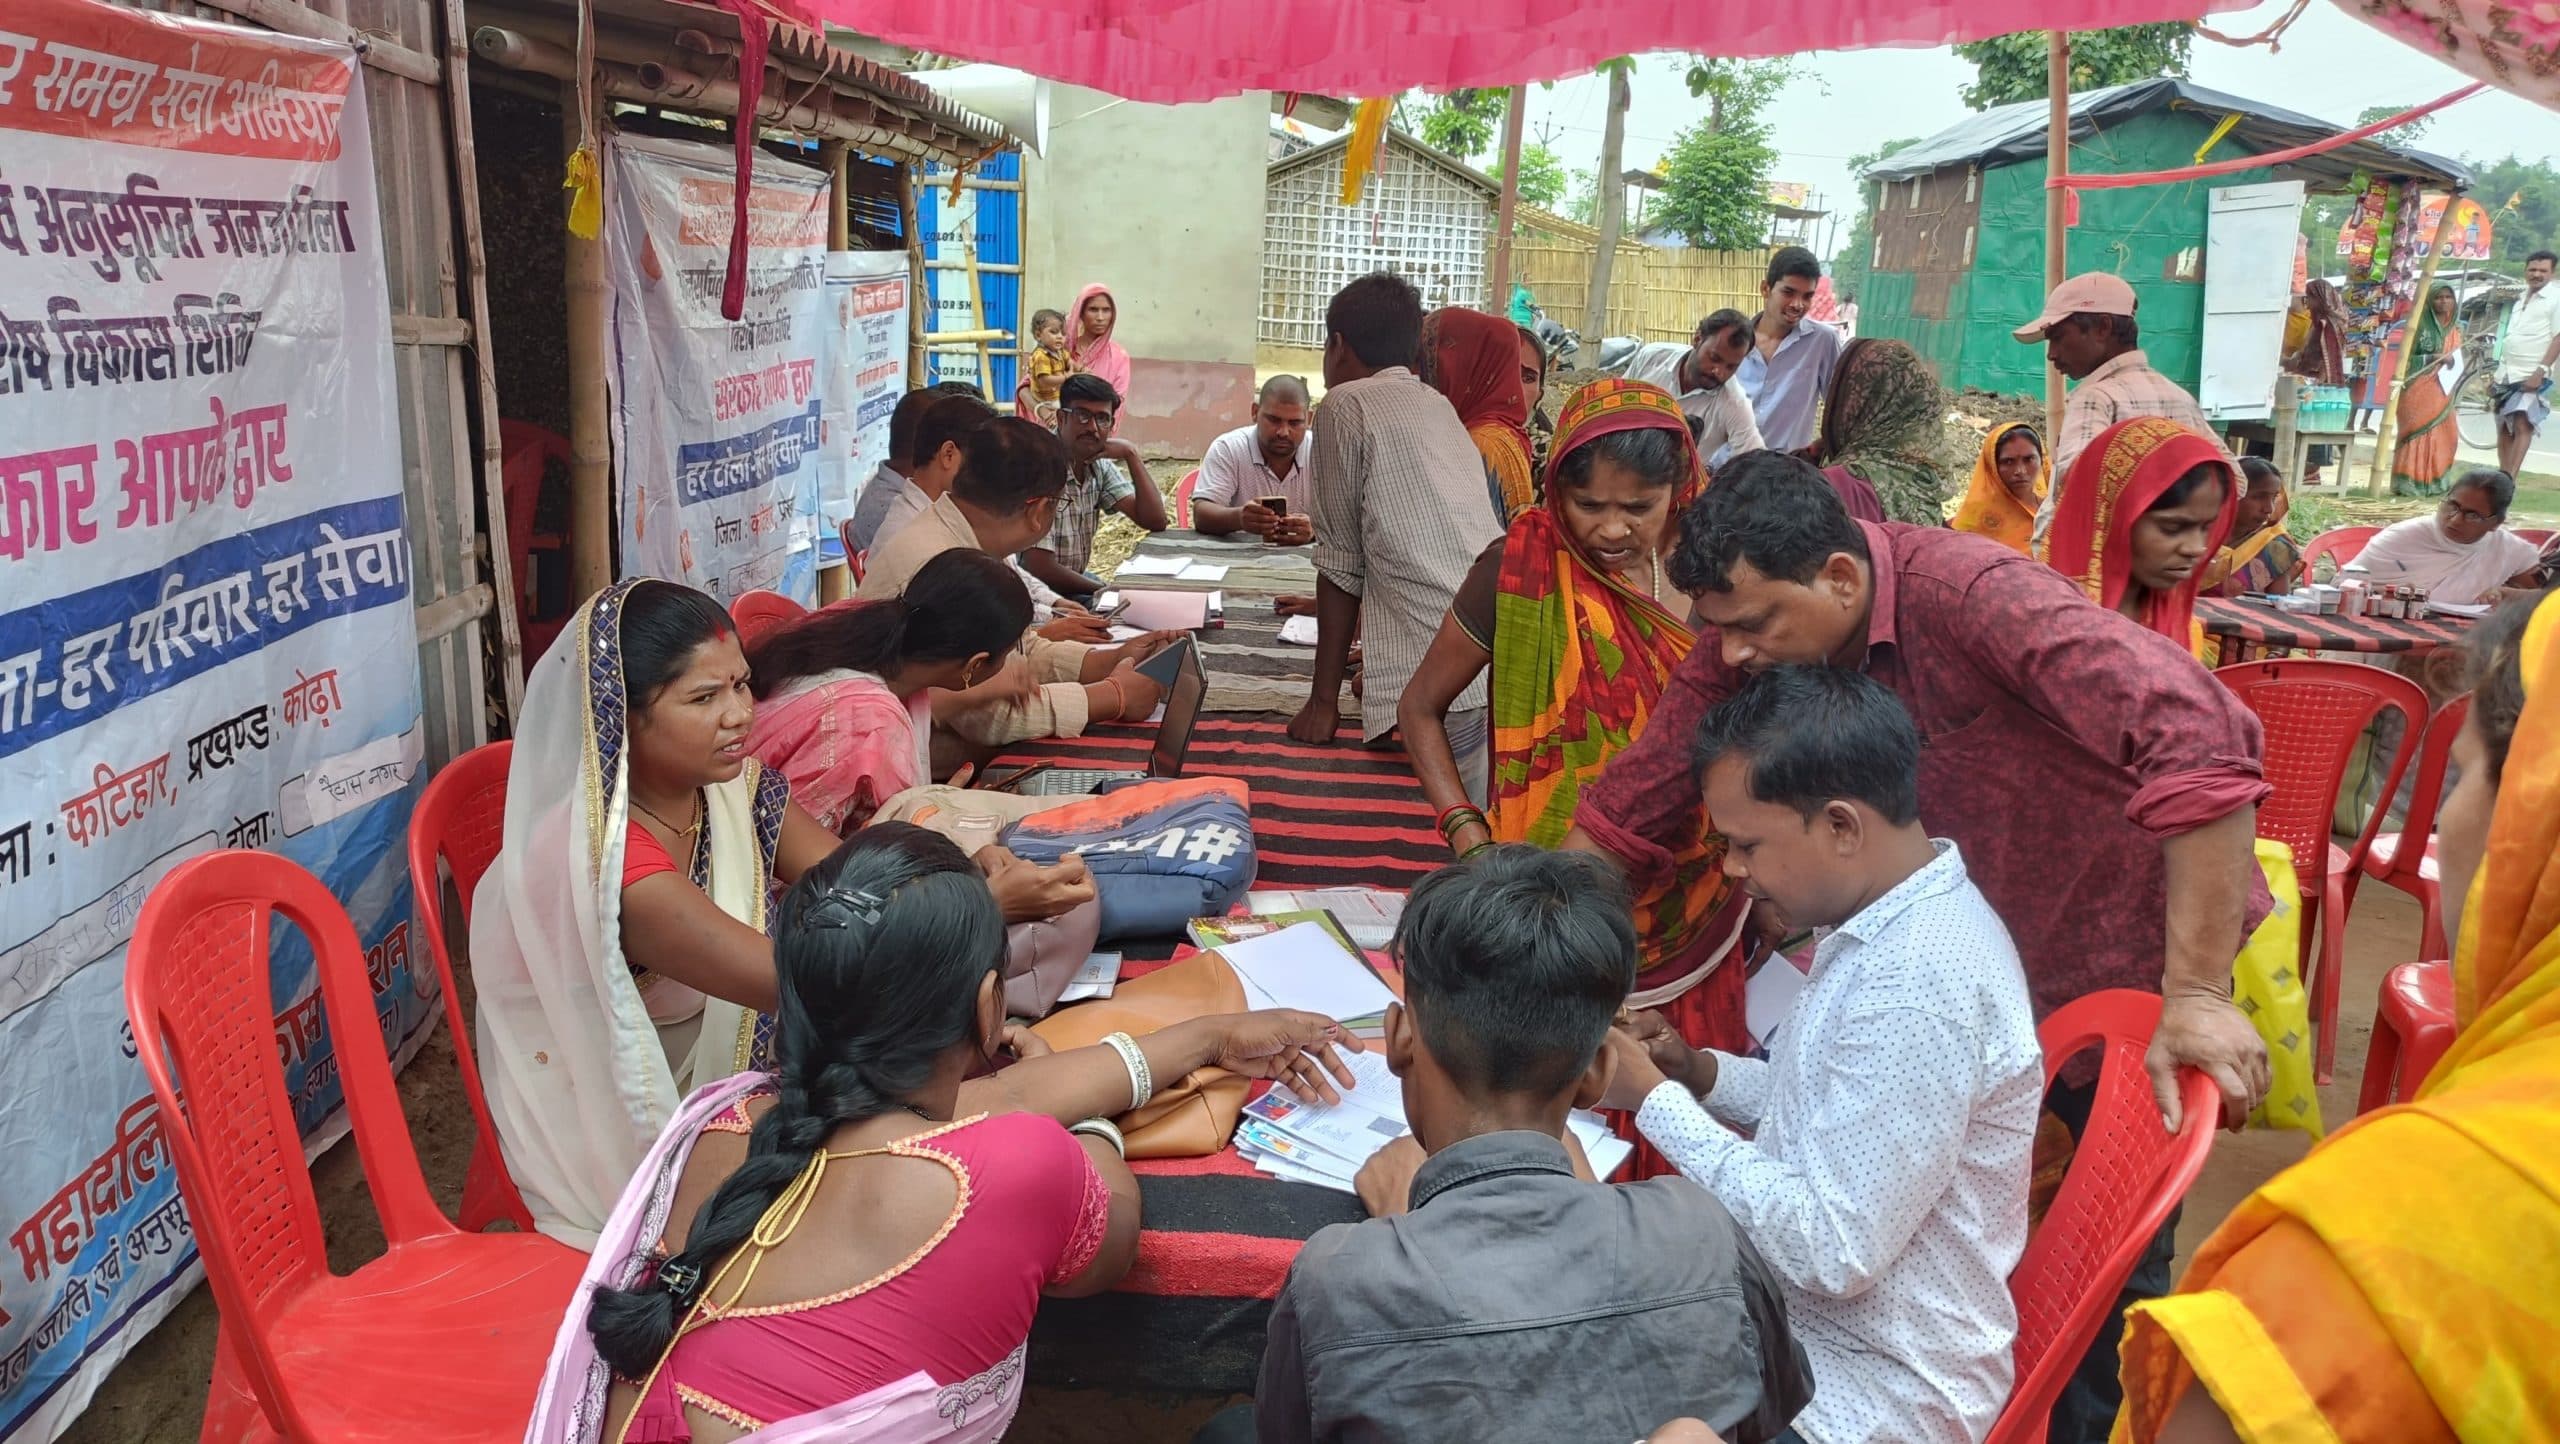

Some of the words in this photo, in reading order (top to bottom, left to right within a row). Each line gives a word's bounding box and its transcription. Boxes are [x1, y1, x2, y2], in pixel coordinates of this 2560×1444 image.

[33, 41, 160, 128] समग्र
[151, 43, 226, 135] सेवा
[24, 172, 204, 284] अनुसूचित
[958, 232, 998, 243] SAKTI
[47, 295, 177, 389] विकास
[173, 292, 263, 377] शिवि
[114, 396, 227, 529] आपके
[230, 402, 293, 509] द्वार
[685, 462, 709, 496] हर
[312, 522, 405, 602] सेवा
[714, 516, 742, 548] जिला
[283, 669, 342, 729] कोढ़ा
[9, 1088, 195, 1283] महादलि
[36, 1278, 92, 1351] जाति
[94, 1237, 121, 1300] एवं
[127, 1182, 193, 1263] अनुसू
